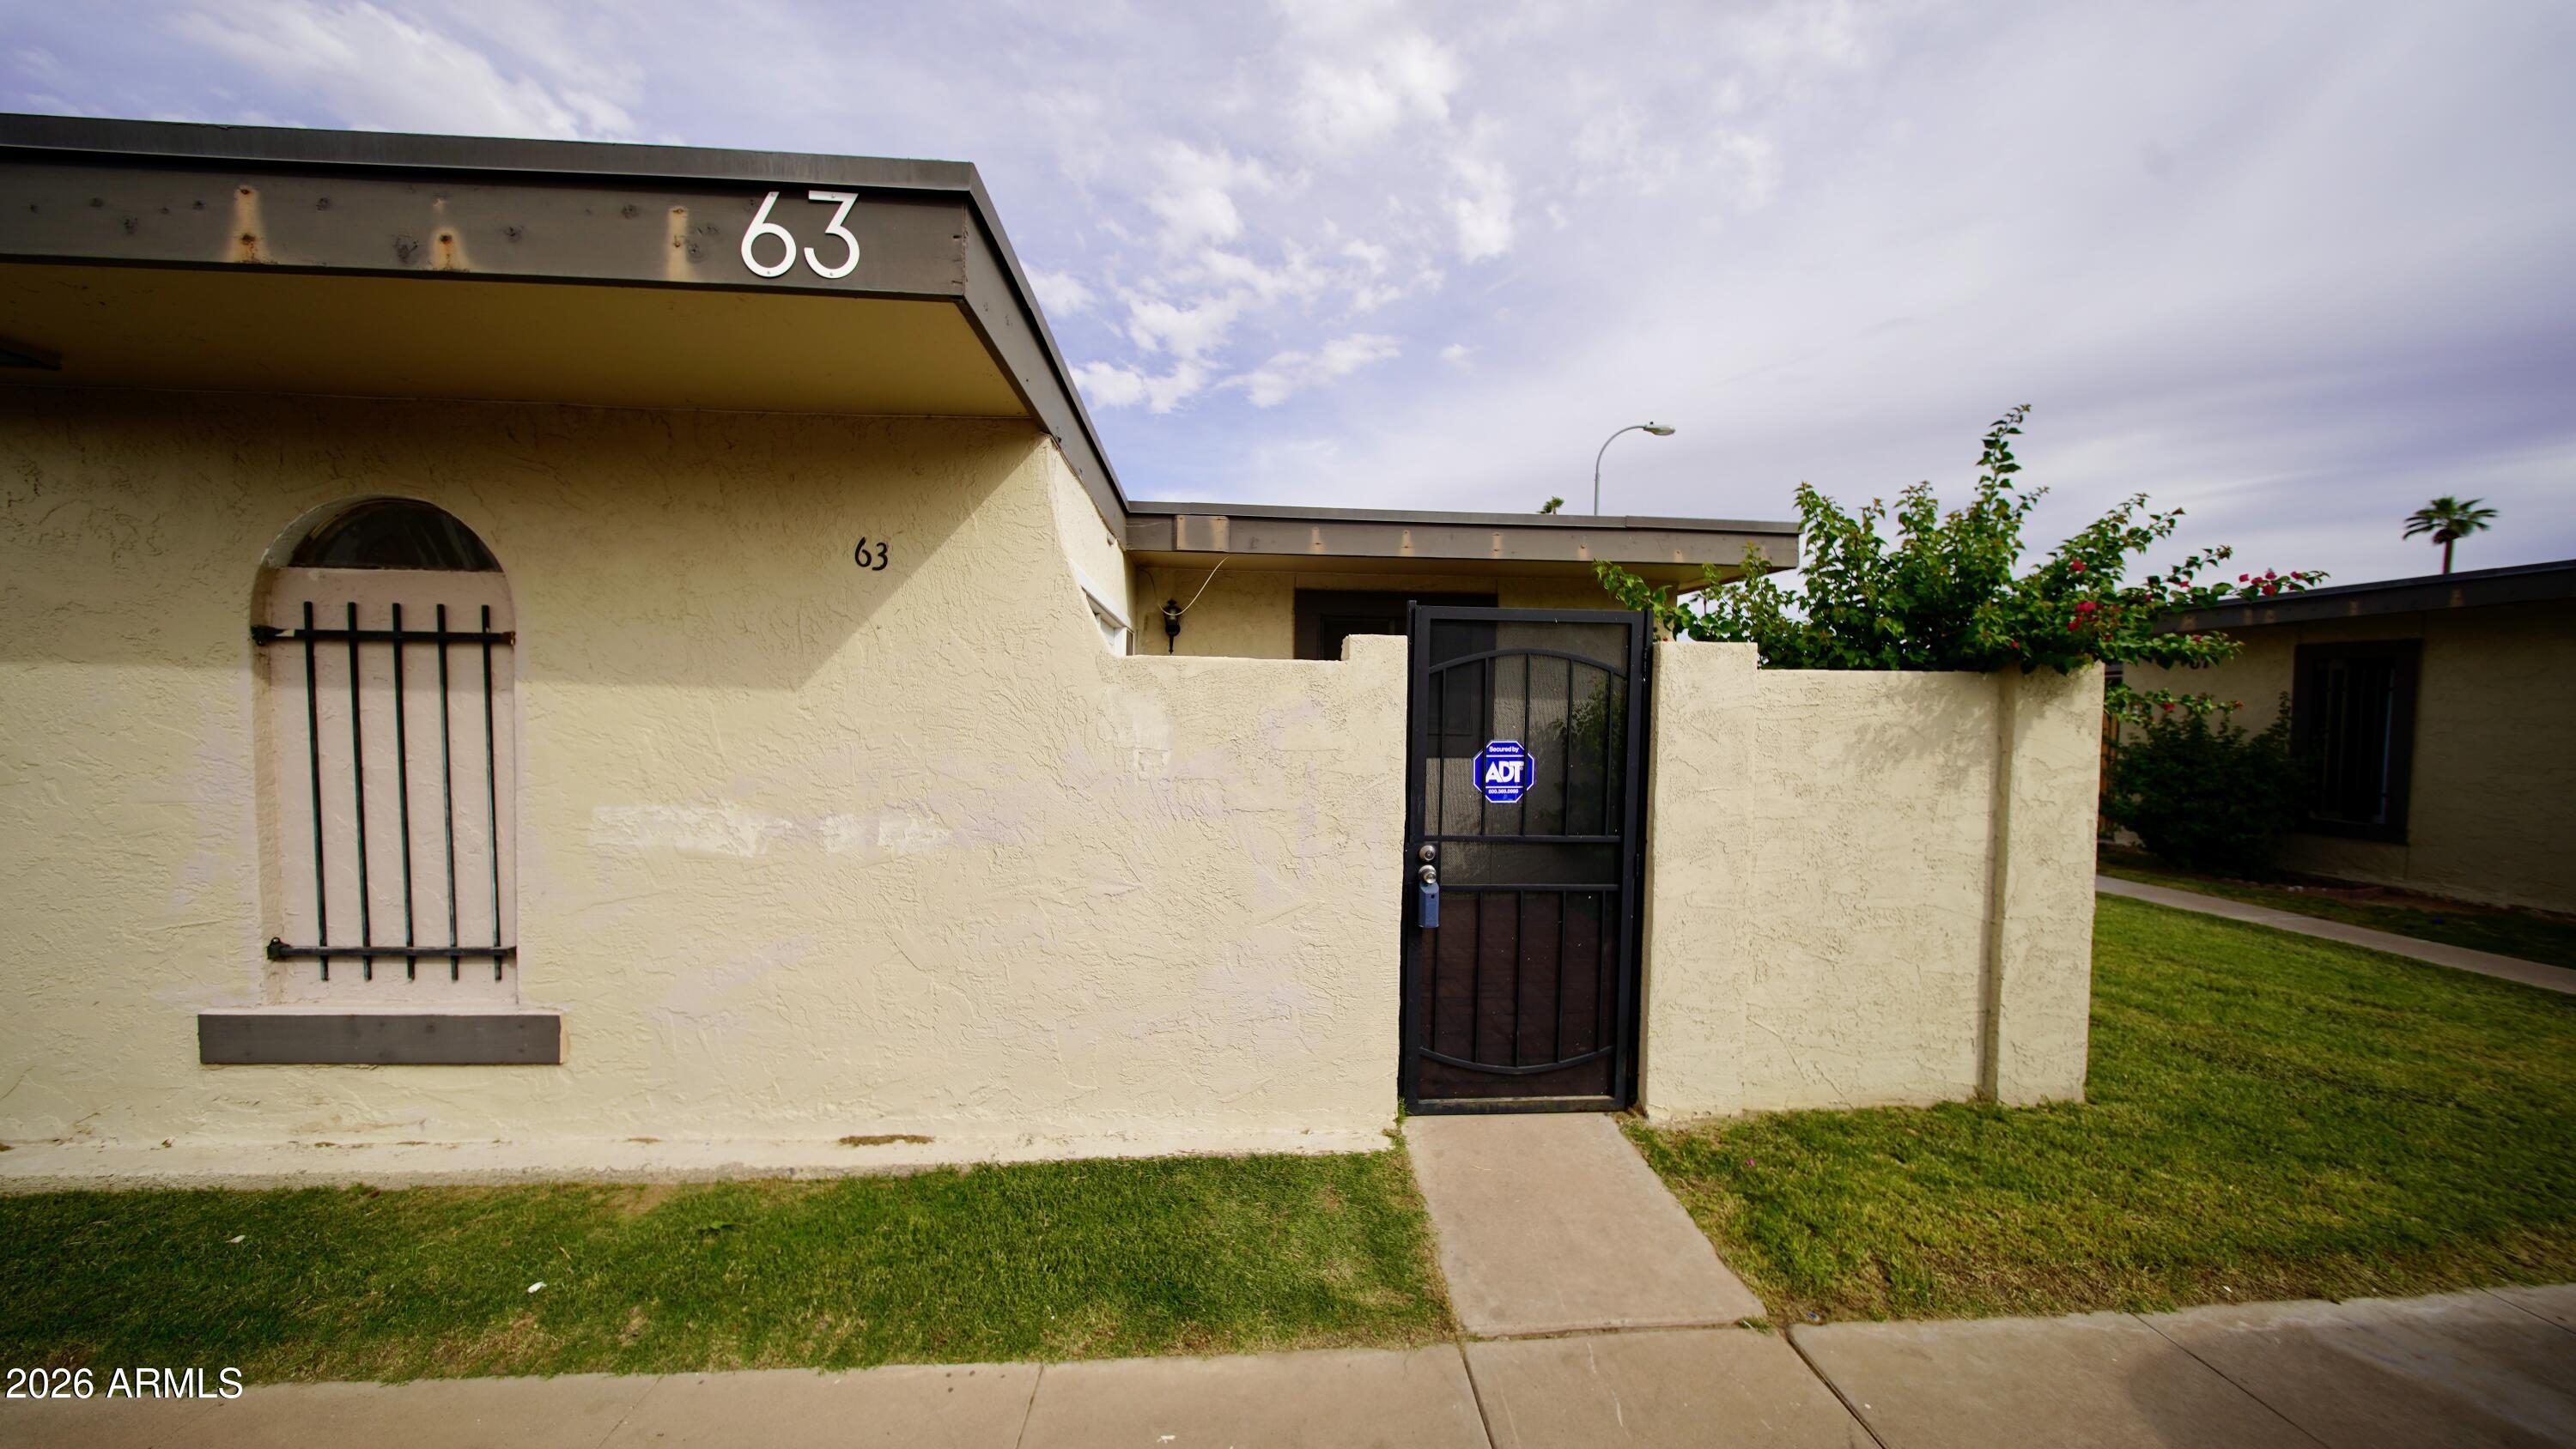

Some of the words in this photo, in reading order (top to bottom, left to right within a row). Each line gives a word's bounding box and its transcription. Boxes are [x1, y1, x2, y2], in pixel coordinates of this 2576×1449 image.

[741, 190, 860, 279] 63
[854, 536, 889, 571] 63
[1485, 761, 1524, 783] ADT
